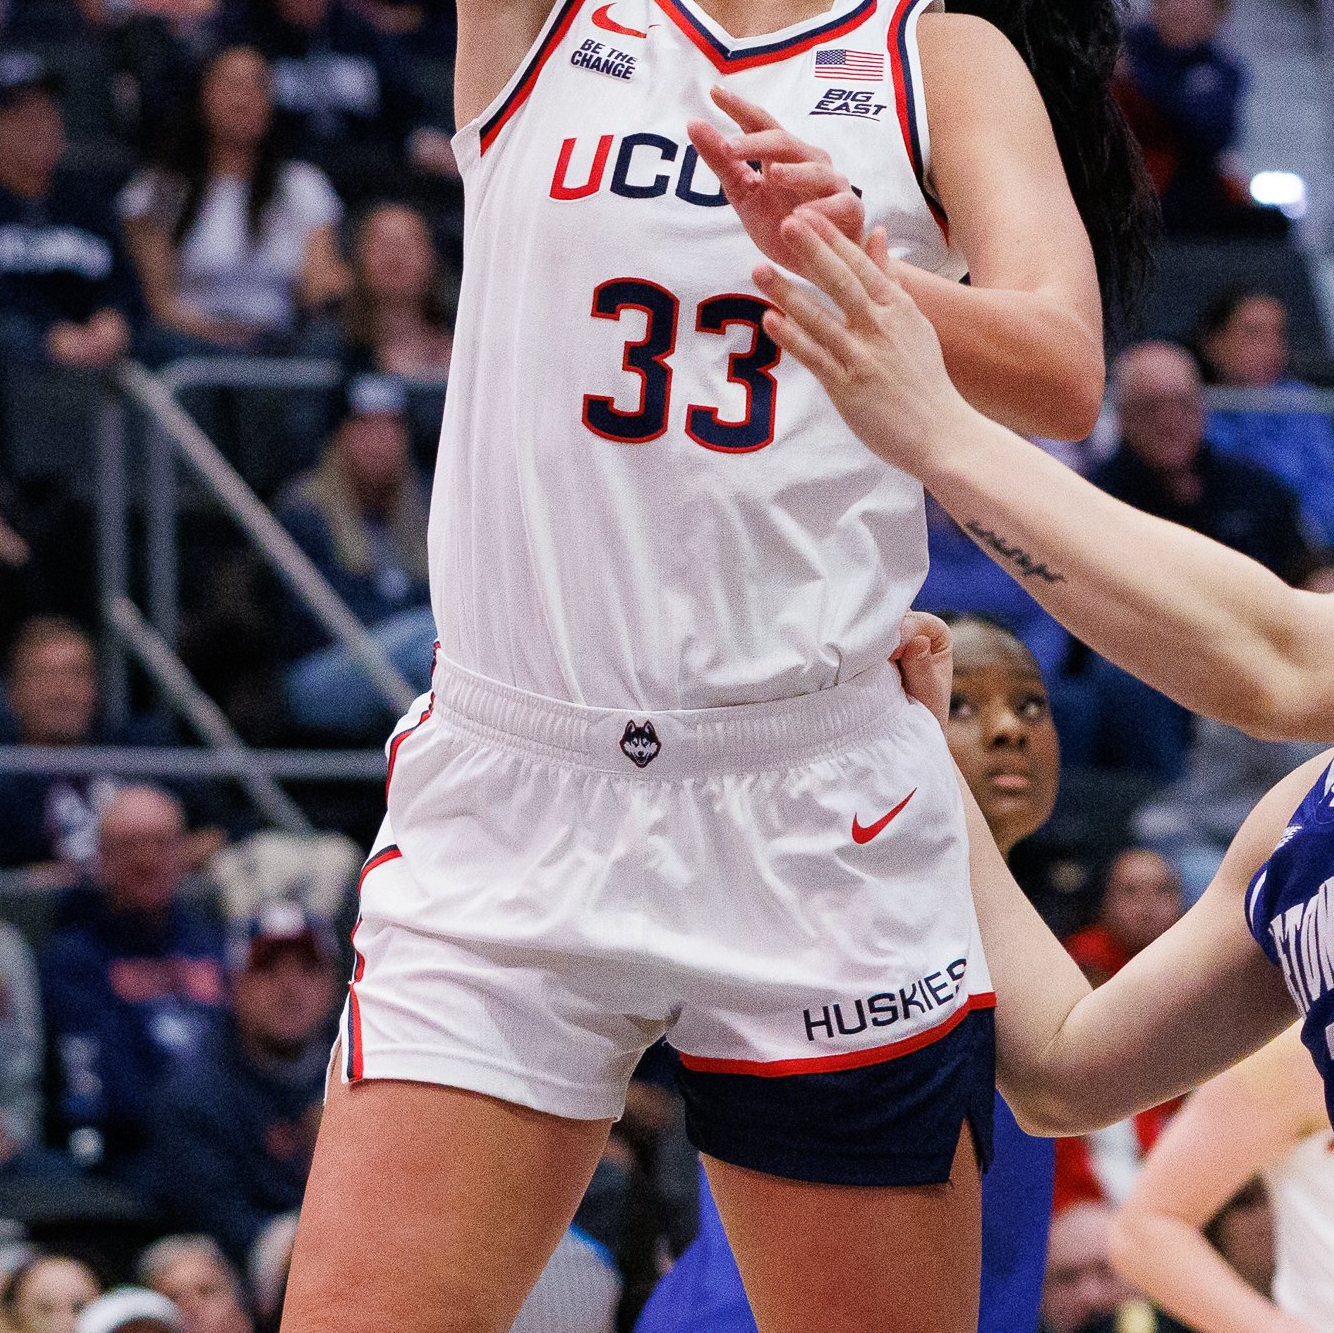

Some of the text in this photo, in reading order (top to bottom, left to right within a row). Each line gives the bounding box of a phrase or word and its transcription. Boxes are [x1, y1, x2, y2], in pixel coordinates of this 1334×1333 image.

[570, 50, 635, 80] CHANGE
[579, 38, 639, 65] BE THE
[814, 99, 888, 116] EAST
[822, 88, 875, 103] BIG
[581, 277, 784, 454] 33
[803, 958, 967, 1041] HUSKIES
